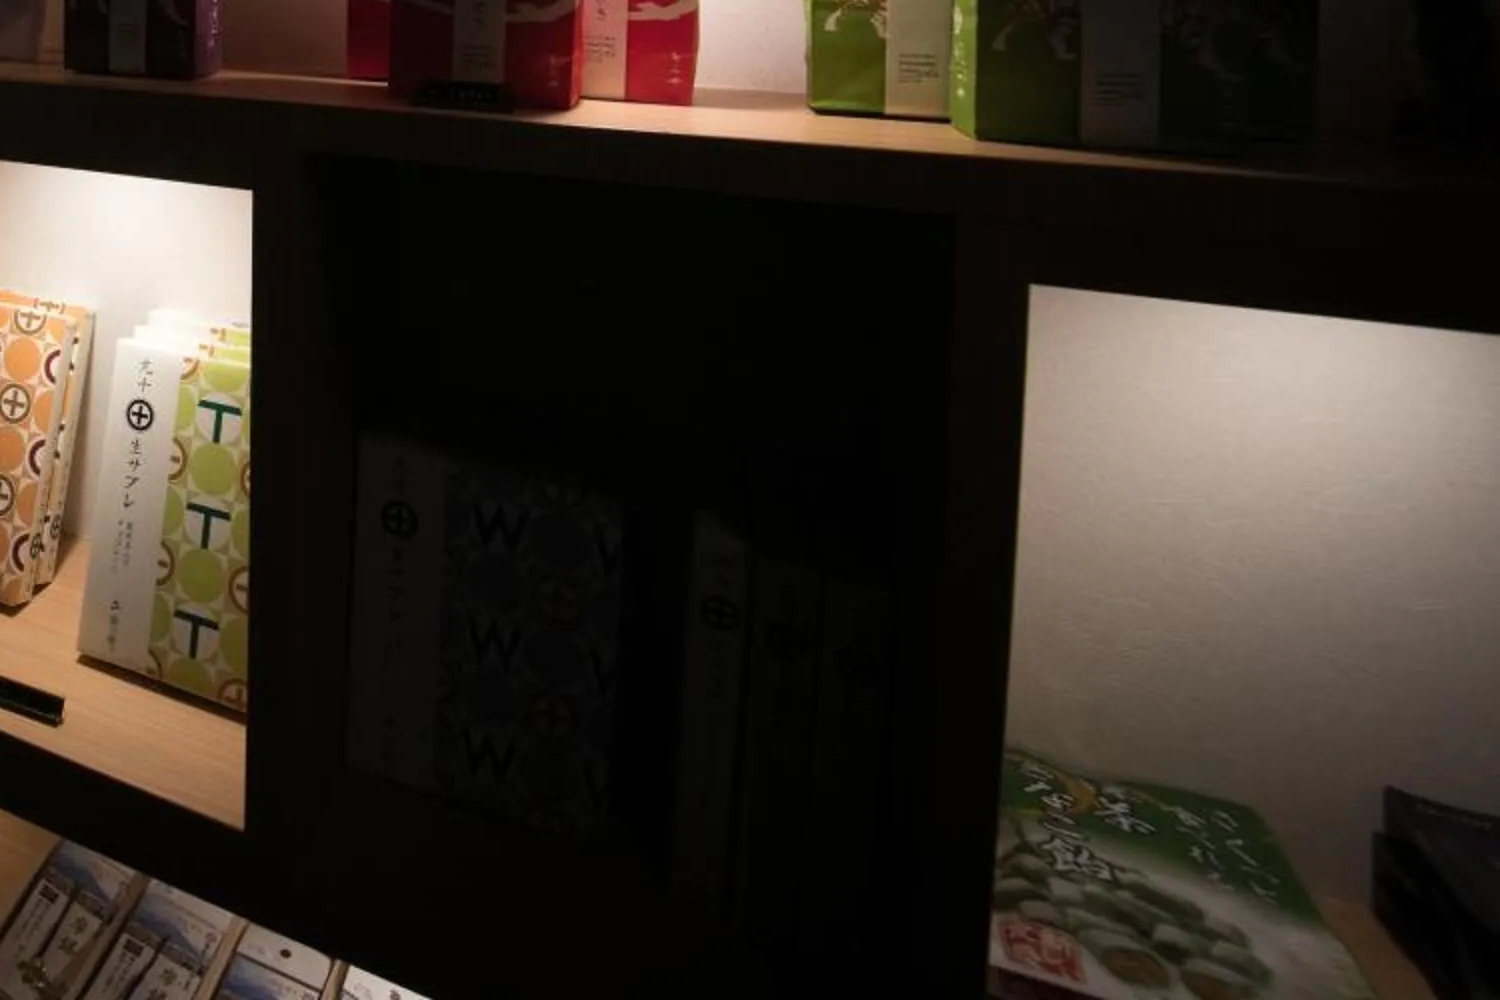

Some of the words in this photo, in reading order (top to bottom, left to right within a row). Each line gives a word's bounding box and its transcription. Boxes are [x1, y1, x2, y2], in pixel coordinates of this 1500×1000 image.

[198, 399, 243, 444] T
[186, 502, 231, 550] T
[474, 502, 530, 547] W
[173, 609, 220, 659] T
[470, 618, 521, 673] W
[463, 727, 517, 784] W
